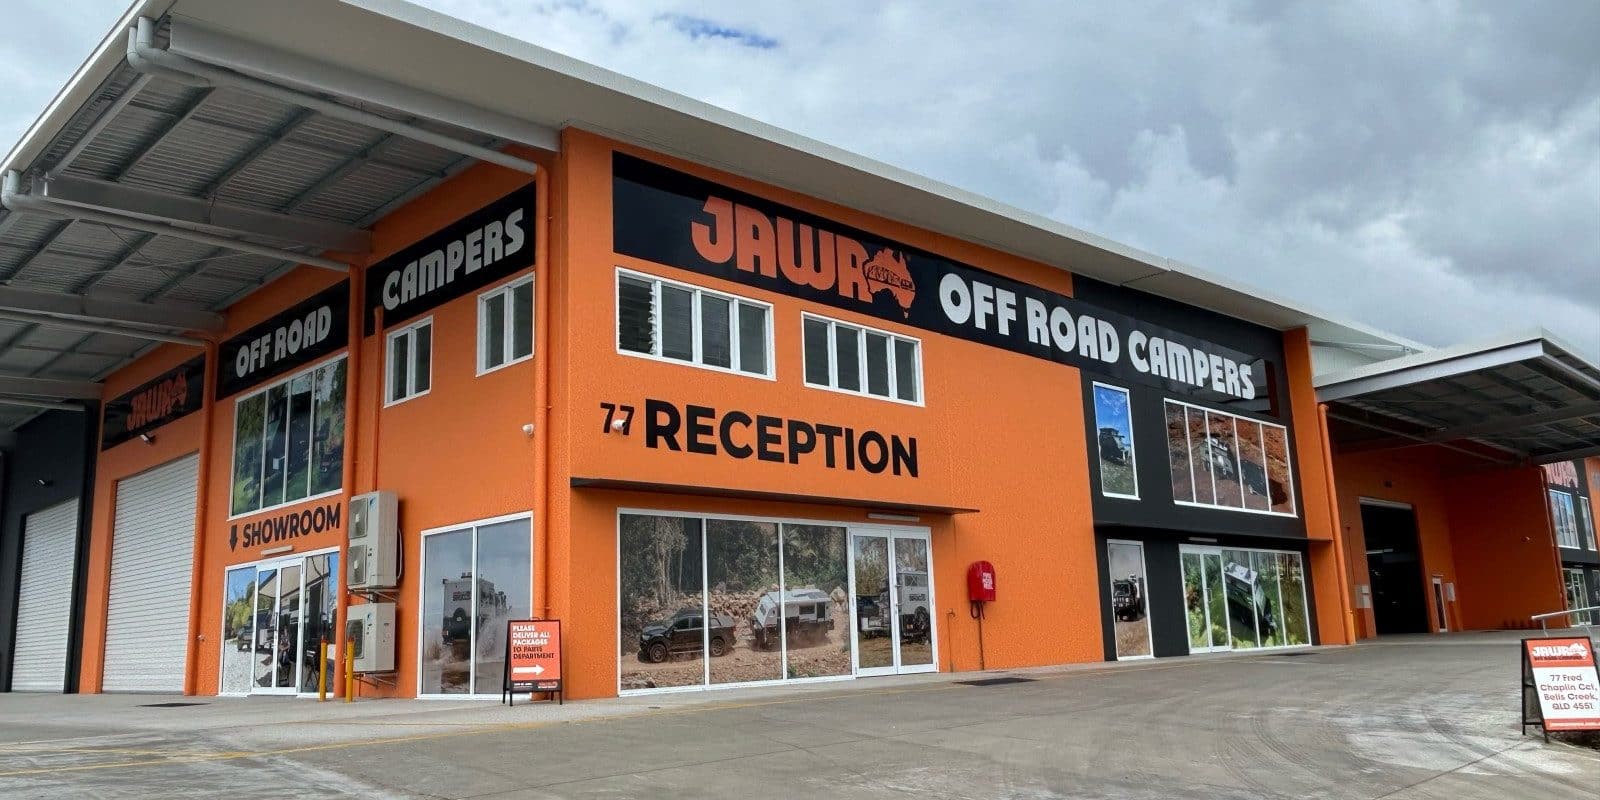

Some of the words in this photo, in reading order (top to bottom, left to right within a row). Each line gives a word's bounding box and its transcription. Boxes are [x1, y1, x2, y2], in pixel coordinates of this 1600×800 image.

[381, 207, 526, 311] CAMPERS
[692, 195, 873, 304] JAWA
[939, 273, 1017, 336] OFF
[1025, 297, 1120, 364] ROAD
[1128, 330, 1256, 401] CAMPERS
[235, 339, 271, 379] OFF
[274, 305, 332, 362] ROAD
[600, 402, 635, 436] 77
[645, 398, 919, 478] RECEPTION
[242, 502, 341, 548] SHOWROOM
[512, 638, 549, 646] PACKAGES
[1540, 684, 1576, 692] Chaplin
[1549, 674, 1561, 682] 77
[1562, 674, 1583, 682] Fred
[1552, 702, 1571, 710] QLD
[1573, 702, 1594, 710] 4551
[1567, 692, 1598, 701] Creek,
